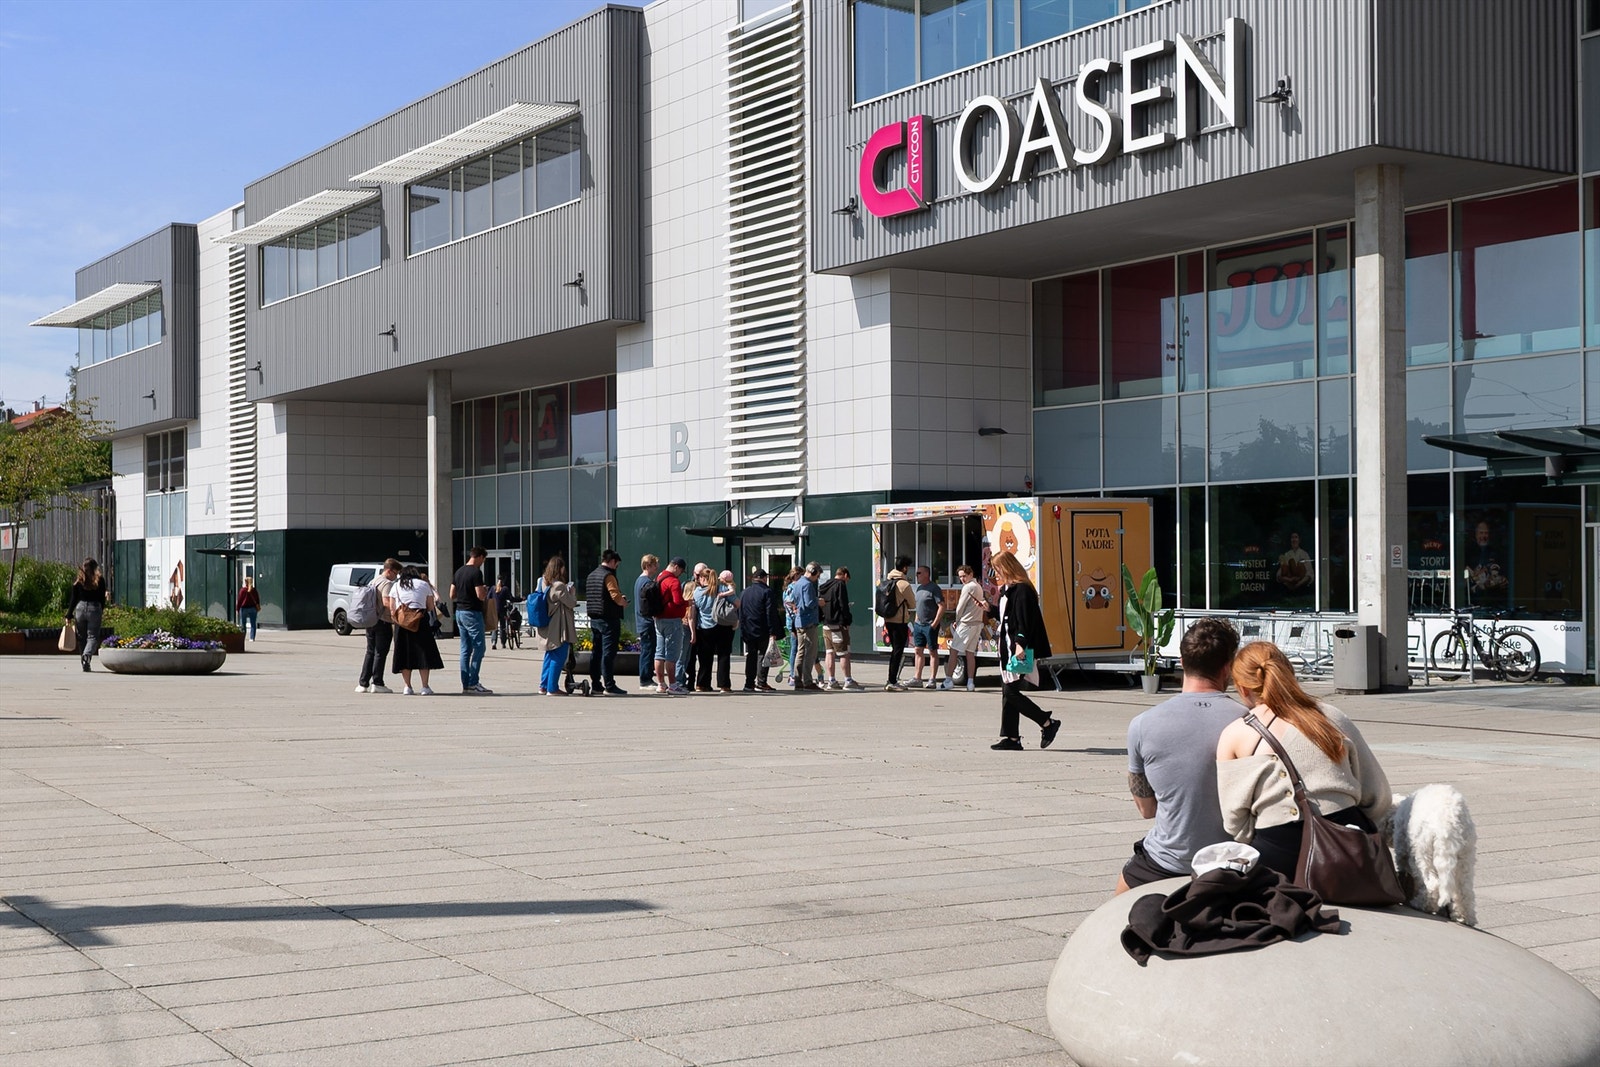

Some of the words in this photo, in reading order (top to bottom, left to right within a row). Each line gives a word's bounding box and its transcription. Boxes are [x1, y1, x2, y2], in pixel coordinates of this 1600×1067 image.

[953, 17, 1244, 194] OASEN
[911, 121, 920, 184] CITYCON
[670, 422, 691, 473] B
[205, 484, 215, 515] A
[1085, 528, 1110, 538] POTA
[1081, 540, 1115, 550] MADRE
[1420, 556, 1445, 566] STORT
[1255, 571, 1271, 580] HELE
[1240, 582, 1265, 592] DAGEN
[1560, 624, 1581, 632] Oasen
